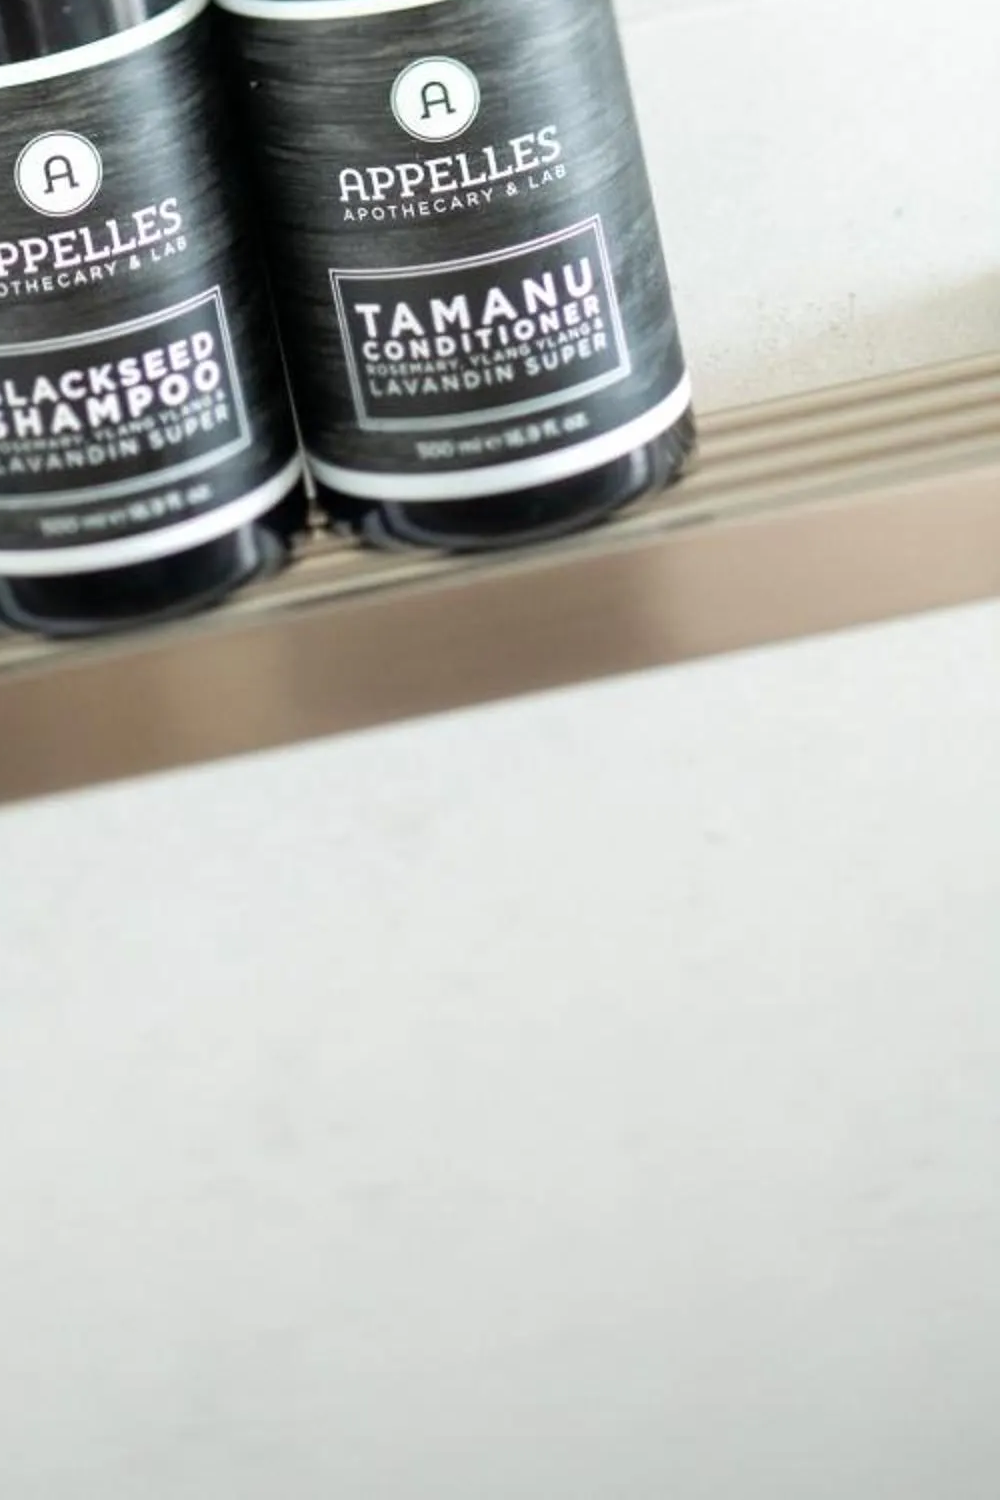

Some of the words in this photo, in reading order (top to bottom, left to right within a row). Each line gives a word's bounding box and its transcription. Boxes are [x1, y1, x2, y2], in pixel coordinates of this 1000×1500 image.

[420, 81, 456, 119] A
[43, 155, 79, 194] A
[339, 124, 562, 202] APPELLES
[343, 188, 494, 222] APOTHECARY
[505, 182, 518, 196] &
[529, 164, 566, 189] LAB
[129, 255, 141, 270] &
[151, 238, 187, 261] LAB
[354, 257, 593, 338] TAMANU
[363, 294, 601, 361] CONDITIONER
[366, 360, 465, 376] ROSEMARY,
[470, 344, 531, 367] YLANG
[536, 323, 590, 349] YLANG
[594, 318, 604, 330] &
[369, 366, 514, 396] LAVANDIN
[524, 332, 607, 376] SUPER
[94, 416, 155, 441] YLANG
[160, 395, 212, 423] YLANG
[148, 404, 229, 450] SUPER
